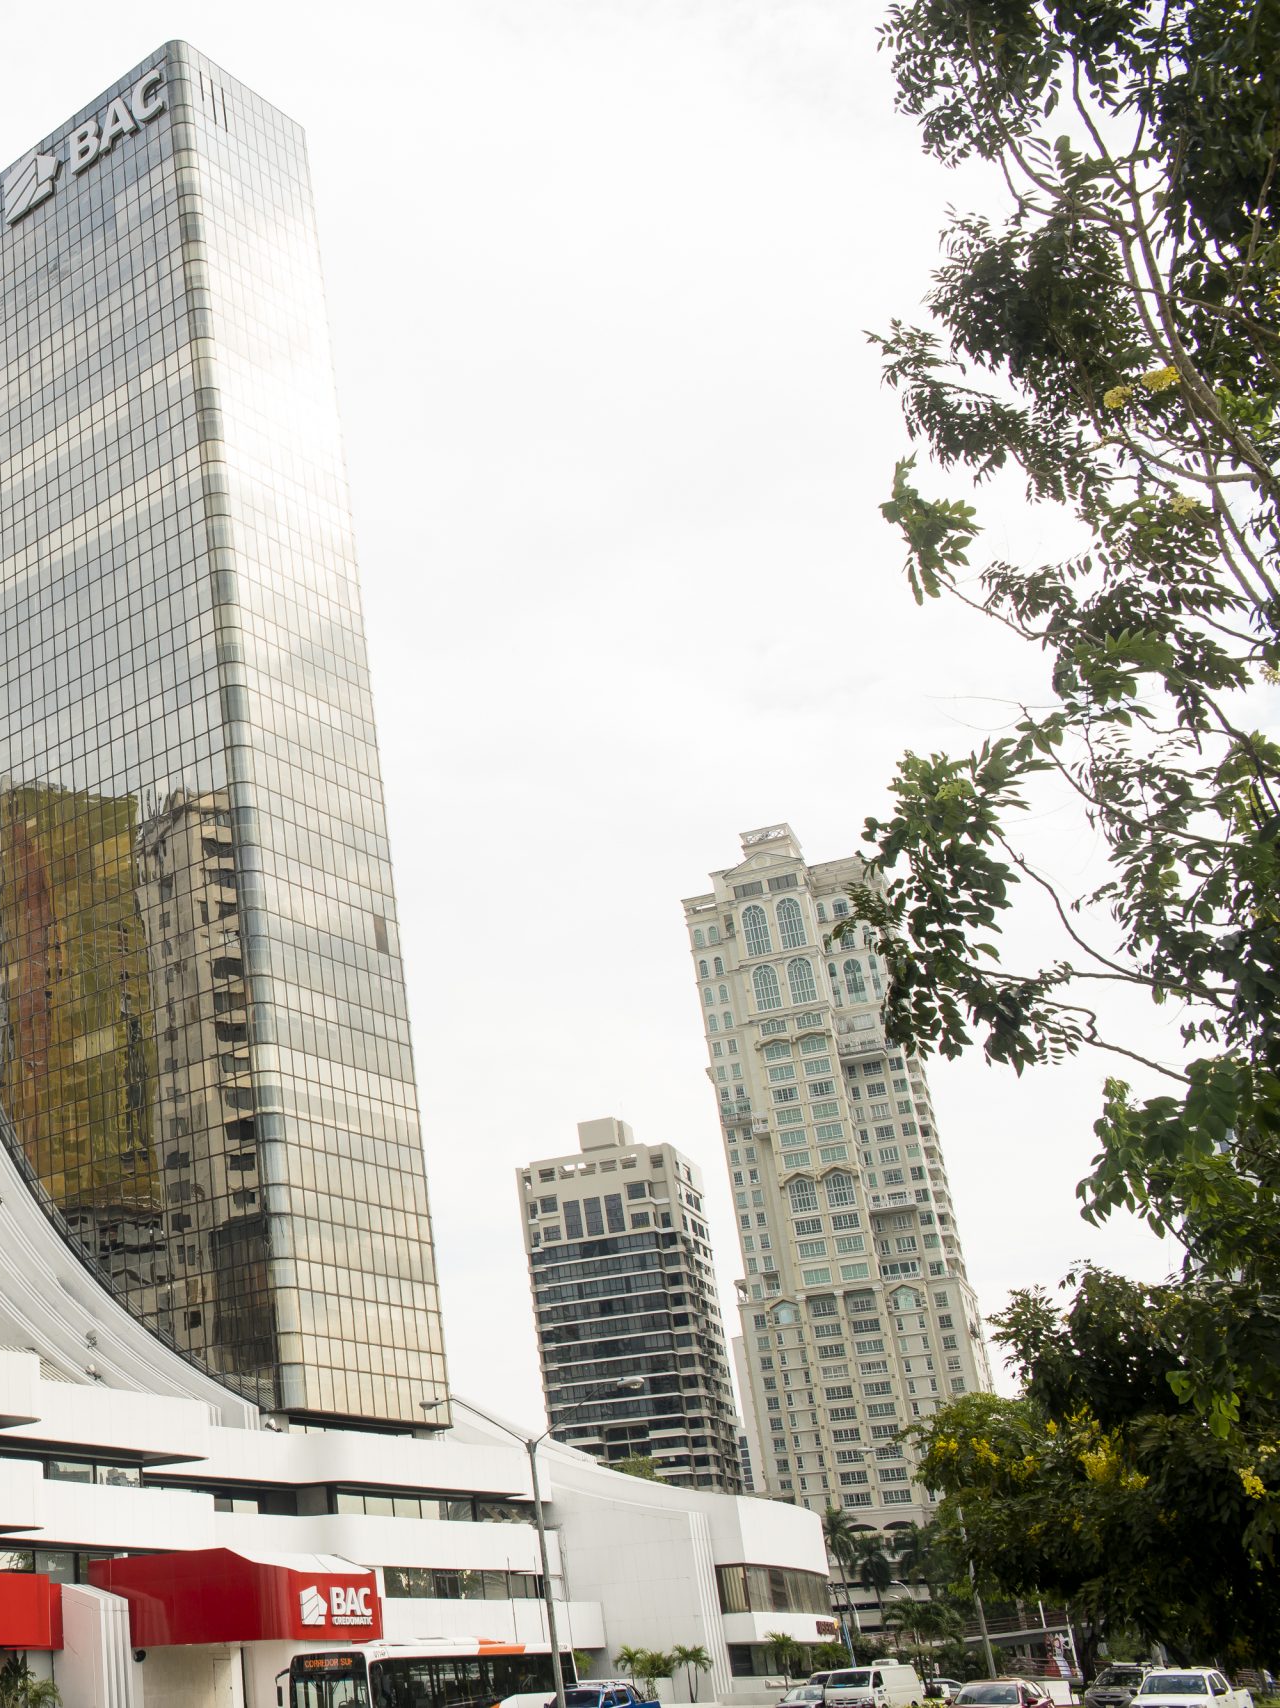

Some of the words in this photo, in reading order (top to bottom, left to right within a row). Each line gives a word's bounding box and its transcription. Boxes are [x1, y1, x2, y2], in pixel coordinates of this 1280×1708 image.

[70, 68, 165, 175] BAC
[330, 1586, 372, 1616] BAC
[332, 1616, 373, 1625] CREDOMATIC
